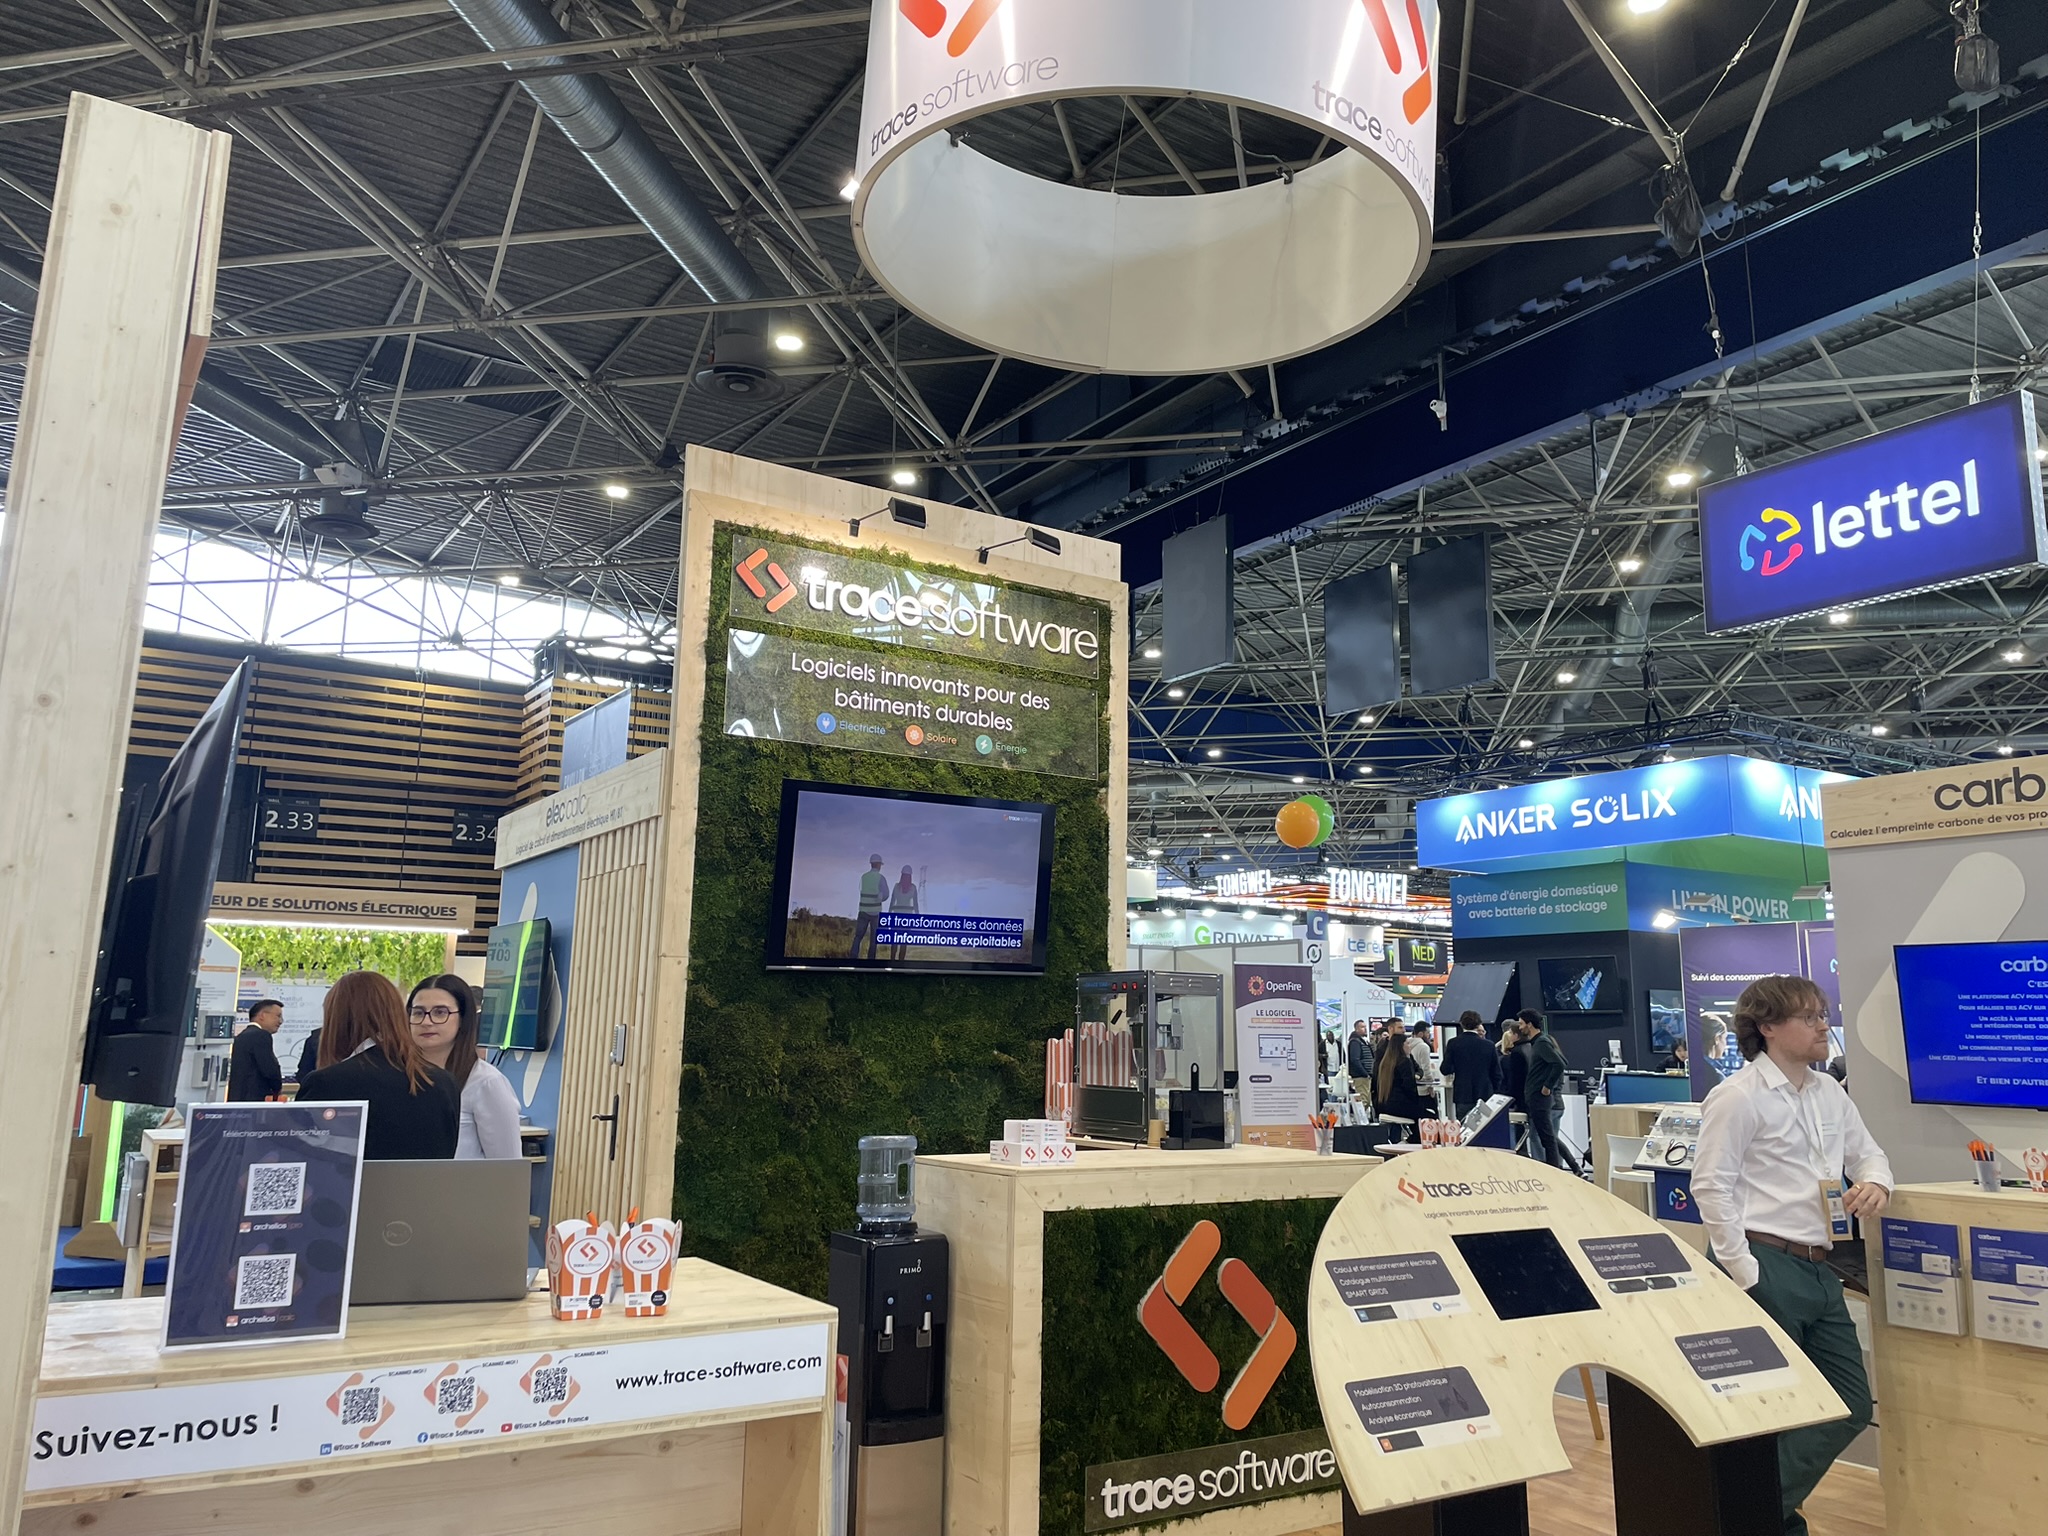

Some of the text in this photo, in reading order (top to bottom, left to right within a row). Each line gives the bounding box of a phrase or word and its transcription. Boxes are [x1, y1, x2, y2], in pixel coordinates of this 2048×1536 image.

[870, 54, 1060, 156] trace software
[1311, 79, 1382, 141] trace
[1812, 459, 1980, 554] lettel
[803, 568, 1099, 660] trace software
[791, 652, 1051, 711] Logiciels innovants pour des
[834, 688, 1013, 732] bâtiments durables
[926, 732, 958, 747] Solaire
[1934, 766, 2047, 811] carb
[264, 810, 315, 831] 2.33
[1455, 787, 1677, 845] ANKER SOLIX
[1830, 828, 1873, 840] Calculez
[1875, 821, 1934, 836] l'empreinte
[1937, 815, 1985, 829] carbone
[1988, 812, 2003, 823] de
[2005, 811, 2025, 822] vos
[455, 823, 497, 843] 2.34
[1215, 869, 1272, 898] TONGWEI
[1327, 867, 1408, 905] TONGWEI
[1456, 882, 1618, 908] Système d'énergie domestique
[247, 896, 268, 908] DE
[272, 898, 358, 912] SOLUTIONS
[361, 900, 457, 917] ÉLECTRIQUES
[1469, 899, 1608, 919] avec batterie de stockage
[1731, 895, 1789, 920] POWER
[880, 914, 1023, 932] et transformons les données
[876, 932, 1022, 948] en informations exploitables
[1411, 944, 1435, 962] NED
[1690, 973, 1724, 982] Suivi des
[1265, 1009, 1296, 1017] LOGICIEL
[1422, 1175, 1545, 1198] trace software
[253, 1221, 288, 1232] archelios
[1345, 1287, 1389, 1299] SMART GRIDS
[240, 1315, 276, 1324] archelios
[615, 1354, 822, 1391] www.trace-software.com
[1393, 1383, 1403, 1391] 3D
[33, 1404, 280, 1460] Suivez-nous !
[429, 1427, 485, 1440] @Trace Software
[514, 1421, 537, 1430] @Trace
[538, 1419, 566, 1427] Software
[334, 1439, 392, 1452] @Trace Software
[1101, 1449, 1336, 1519] trace software
